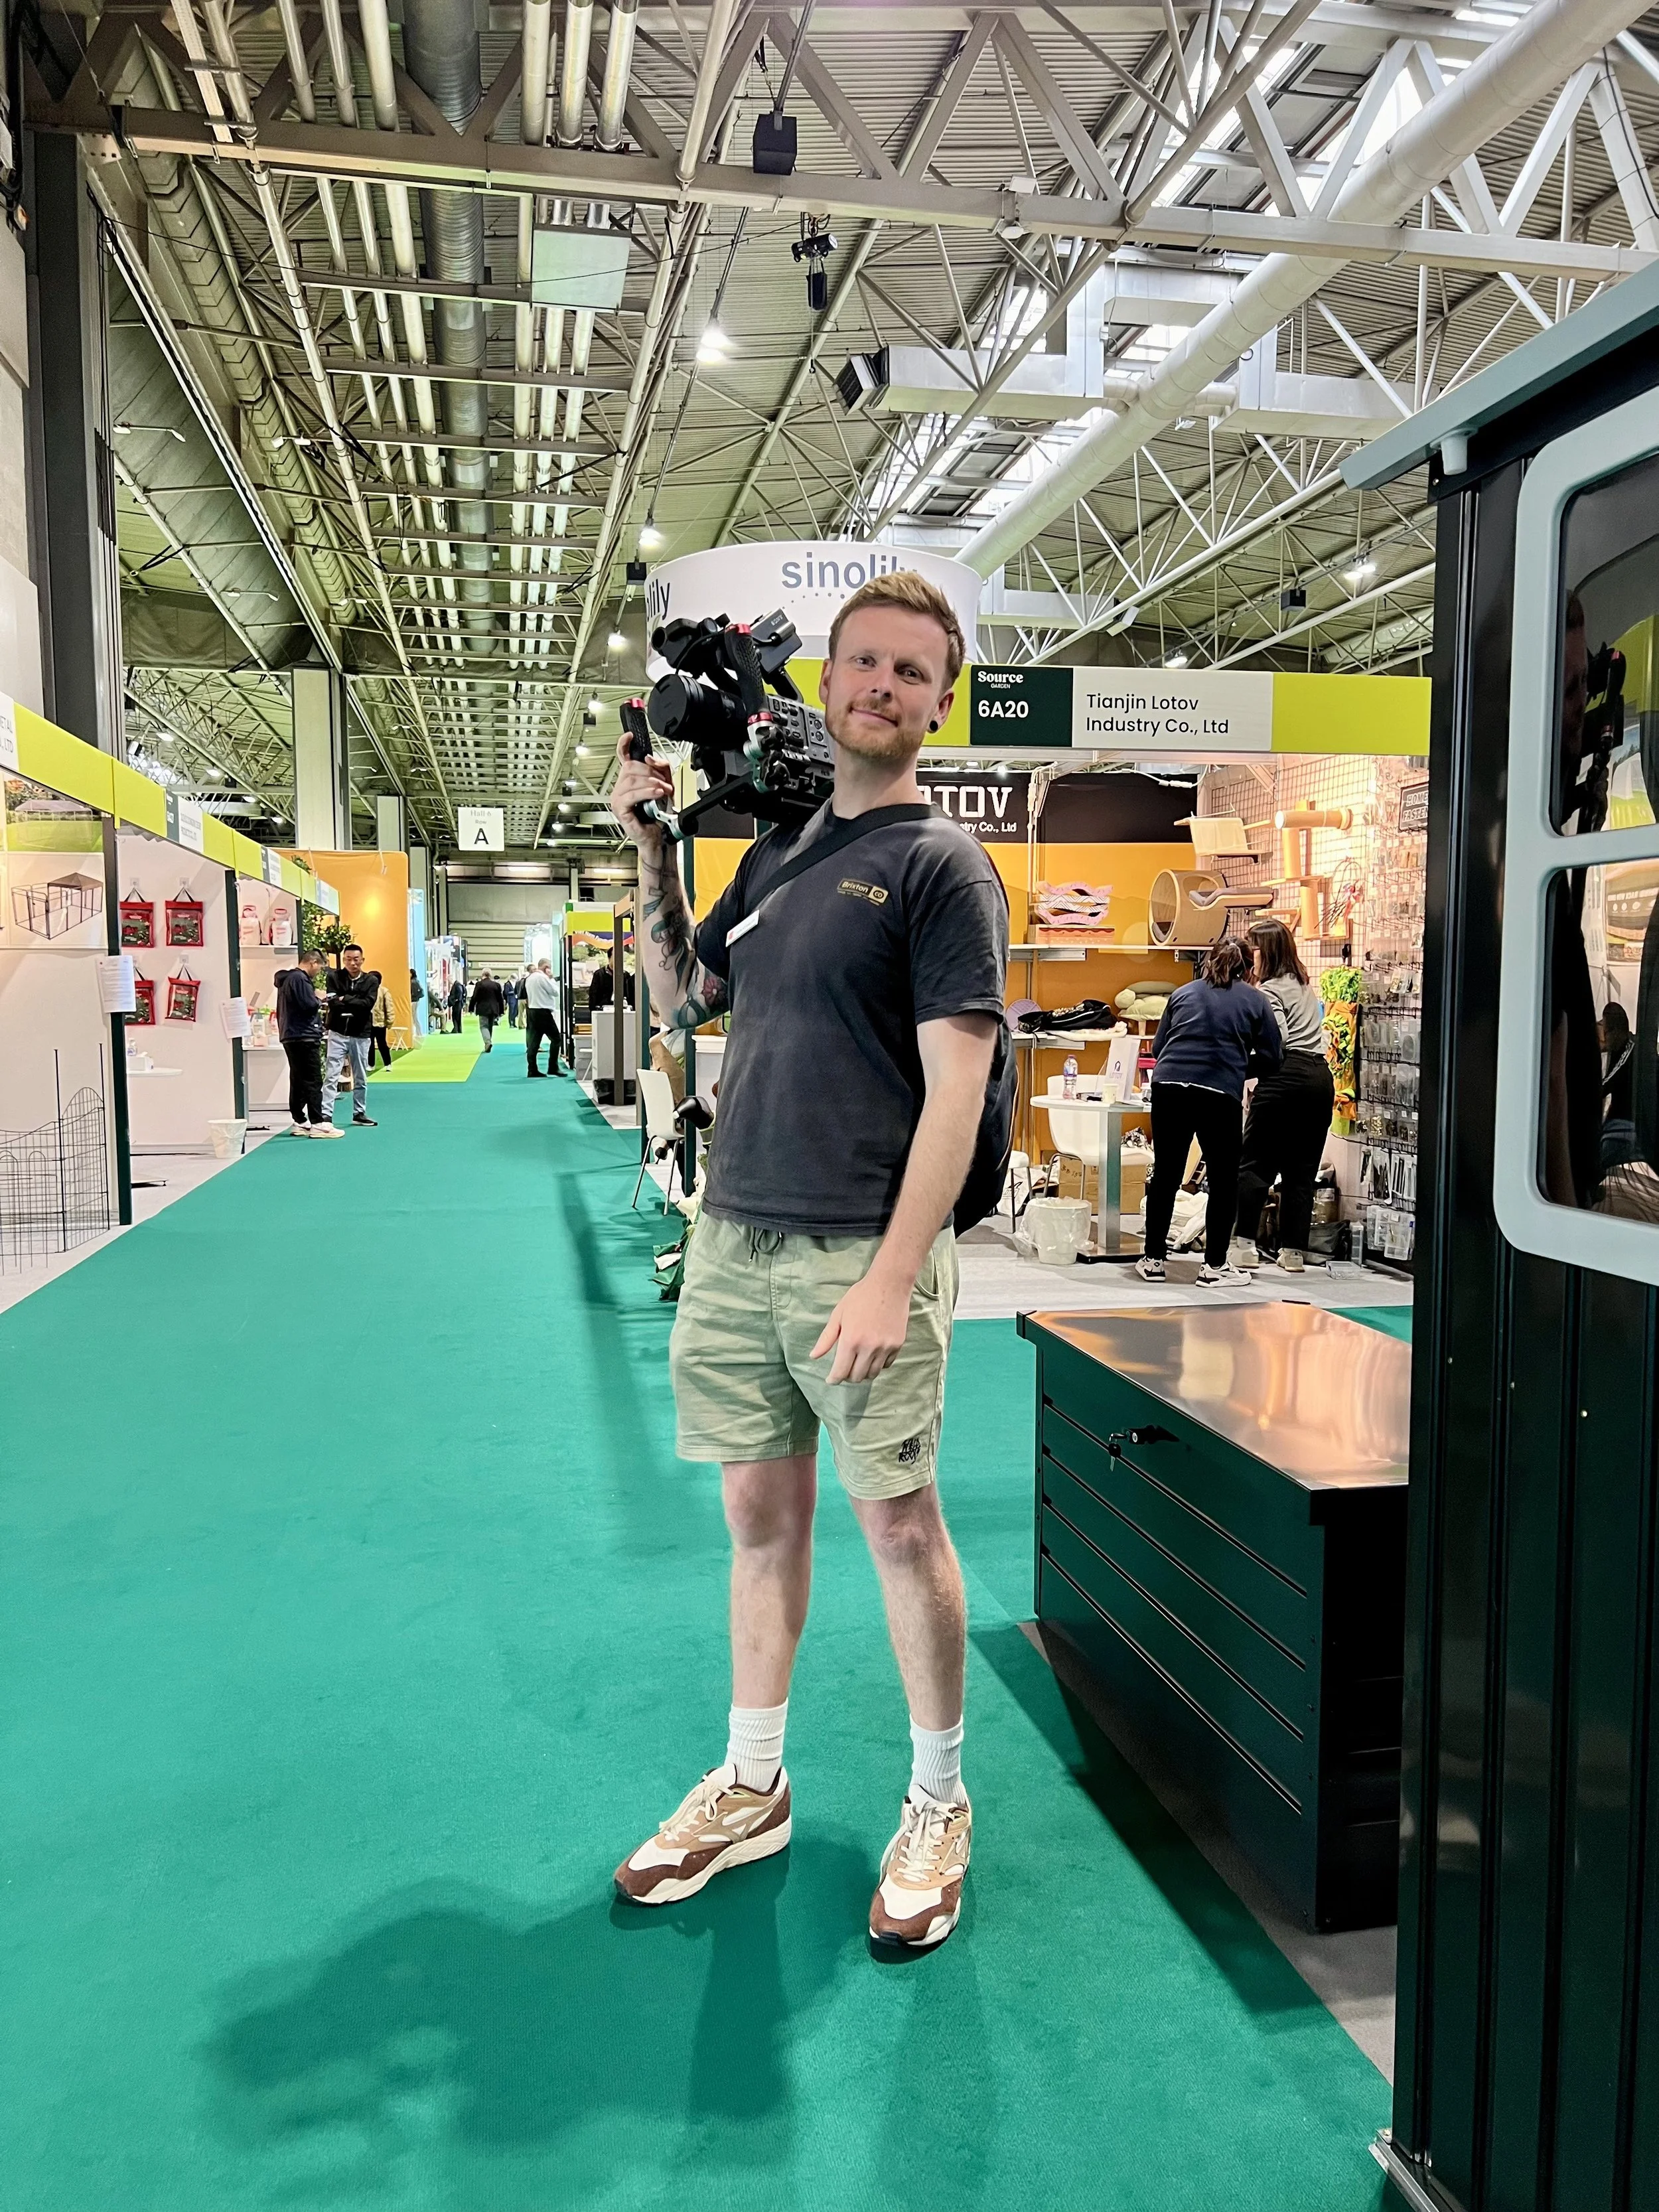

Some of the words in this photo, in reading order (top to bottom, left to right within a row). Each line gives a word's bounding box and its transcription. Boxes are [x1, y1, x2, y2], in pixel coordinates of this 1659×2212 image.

[782, 552, 917, 589] sinolil
[977, 670, 1024, 684] Source
[978, 700, 1029, 718] 6A20
[1086, 693, 1146, 713] Tianjin
[1152, 696, 1198, 710] Lotov
[1086, 717, 1161, 737] Industry
[1165, 719, 1198, 735] Co.,
[1203, 719, 1228, 733] Ltd
[979, 821, 999, 834] Co.,
[1001, 822, 1017, 832] Ltd
[474, 828, 489, 845] A
[841, 881, 869, 893] Brixton
